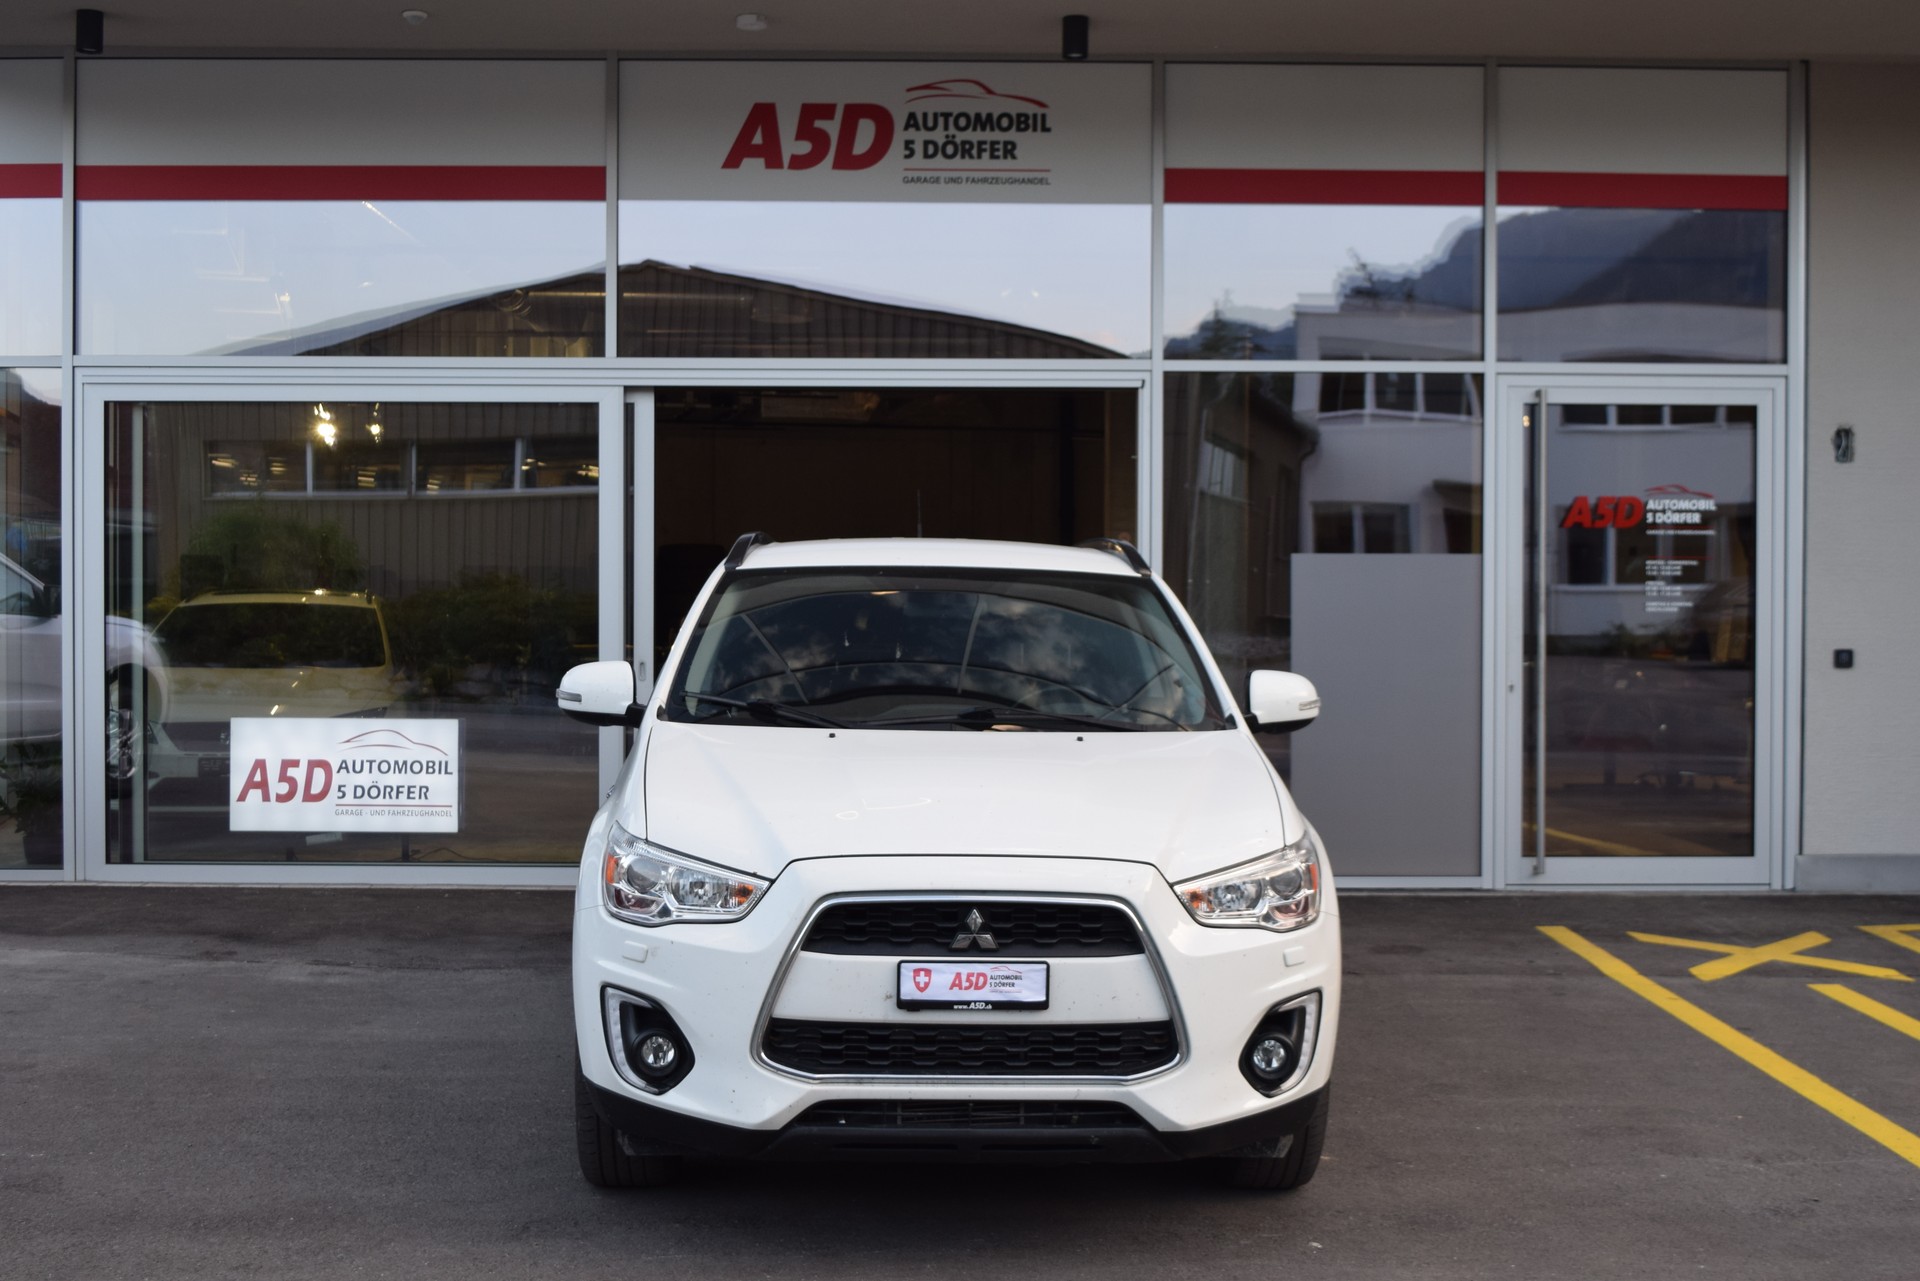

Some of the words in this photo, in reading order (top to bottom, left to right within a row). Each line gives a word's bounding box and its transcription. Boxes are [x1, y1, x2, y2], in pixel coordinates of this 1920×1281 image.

[903, 112, 1052, 133] AUTOMOBIL
[721, 102, 895, 170] A5D
[903, 140, 916, 159] 5
[923, 135, 1018, 160] DÖRFER
[902, 176, 941, 185] GARAGE
[943, 176, 963, 185] UND
[965, 176, 1051, 186] FAHRZEUGHANDEL
[1560, 495, 1645, 529] A5D
[1646, 499, 1717, 511] AUTOMOBIL
[1655, 510, 1701, 524] DÖRFER
[336, 759, 453, 775] AUTOMOBIL
[236, 758, 334, 803] A5D
[337, 785, 347, 800] 5
[353, 781, 430, 800] DÖRFER
[334, 808, 363, 816] GARAGE
[387, 809, 453, 817] FAHRZEUGHANDEL
[949, 972, 988, 991] A5D
[994, 980, 1015, 988] DÖRFER
